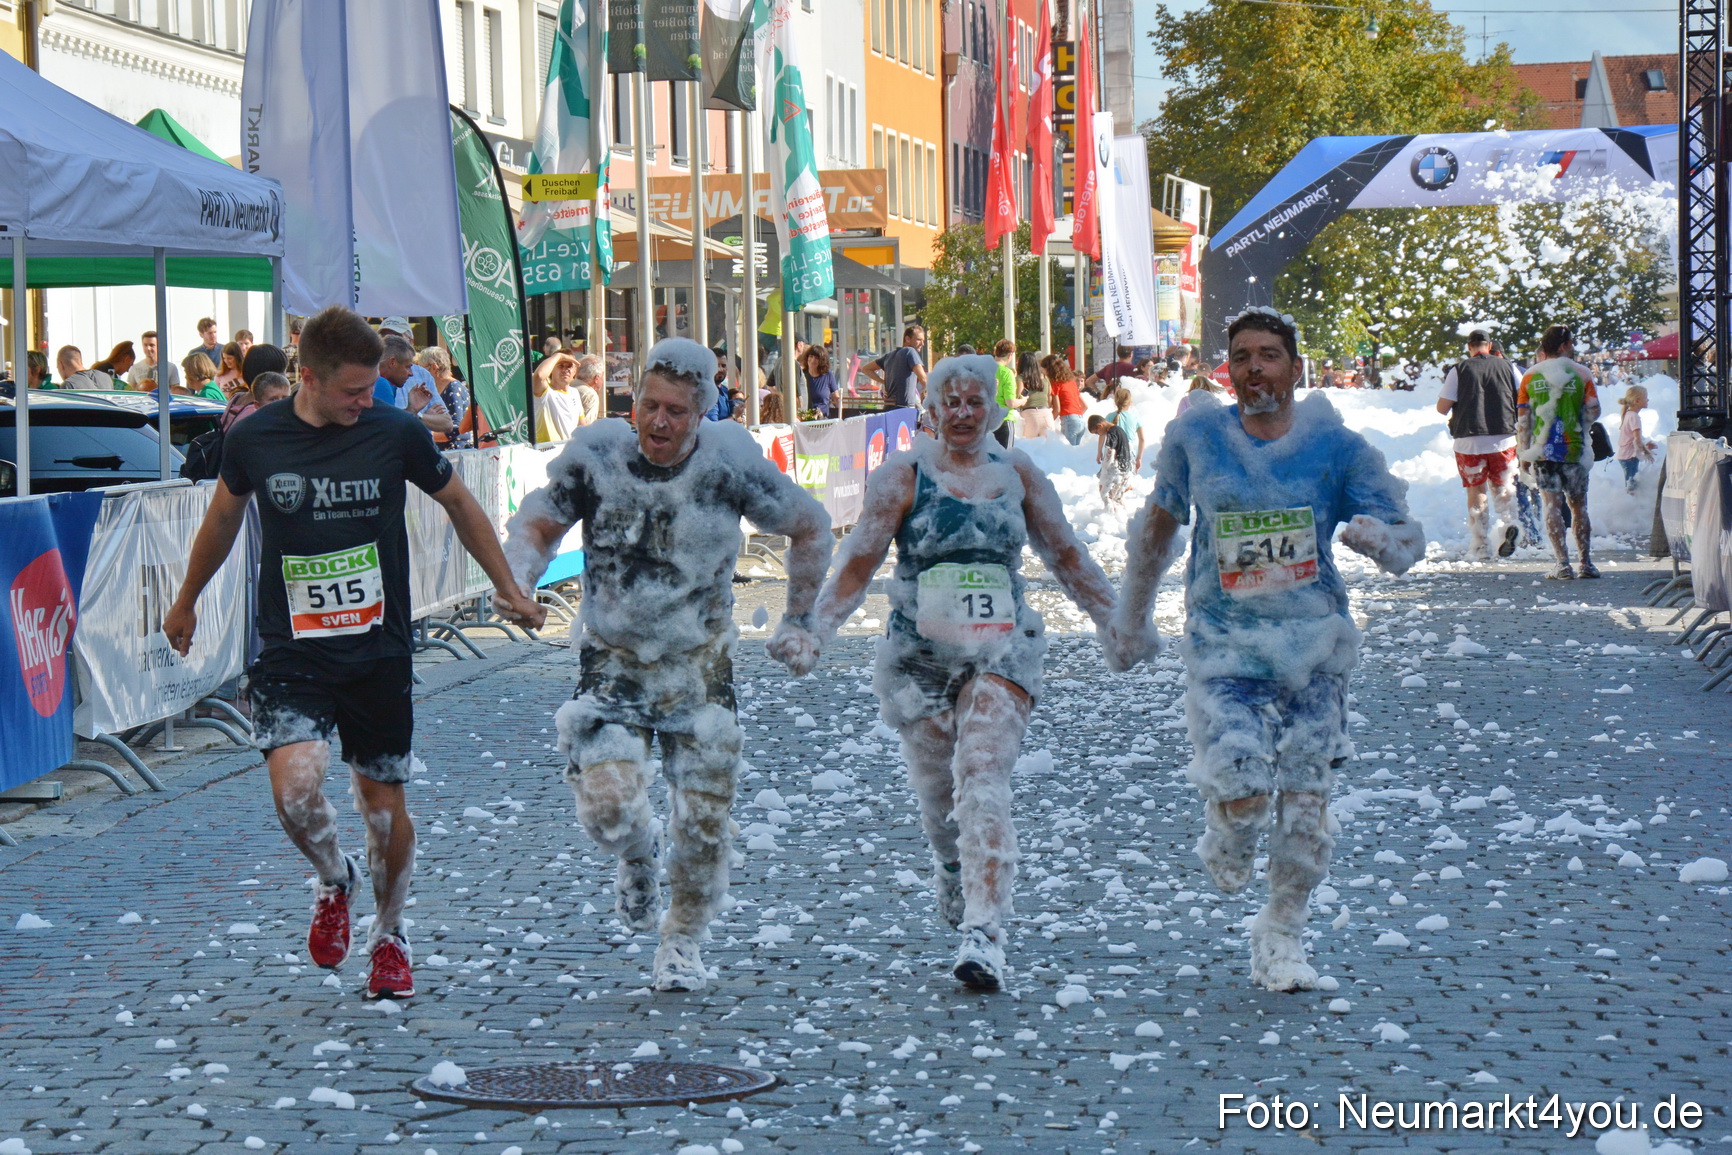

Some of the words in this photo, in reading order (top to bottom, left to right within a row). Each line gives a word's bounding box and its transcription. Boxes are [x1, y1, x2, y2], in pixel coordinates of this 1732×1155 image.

[541, 179, 581, 187] Duschen
[544, 187, 578, 196] Freibad
[197, 187, 231, 228] PARTL
[227, 192, 270, 233] Neumarkt
[1225, 229, 1266, 258] PARTL
[1263, 184, 1331, 232] NEUMARKT
[1113, 299, 1125, 328] PARTL
[275, 479, 297, 489] XLETIX
[311, 477, 382, 508] XLETIX
[313, 511, 326, 520] Ein
[328, 510, 351, 520] Team,
[352, 508, 365, 518] Ein
[289, 548, 373, 578] BOCK
[1237, 536, 1296, 566] 514
[307, 578, 366, 609] 515
[961, 593, 995, 618] 13
[10, 587, 75, 680] Hervis
[321, 612, 361, 626] SVEN
